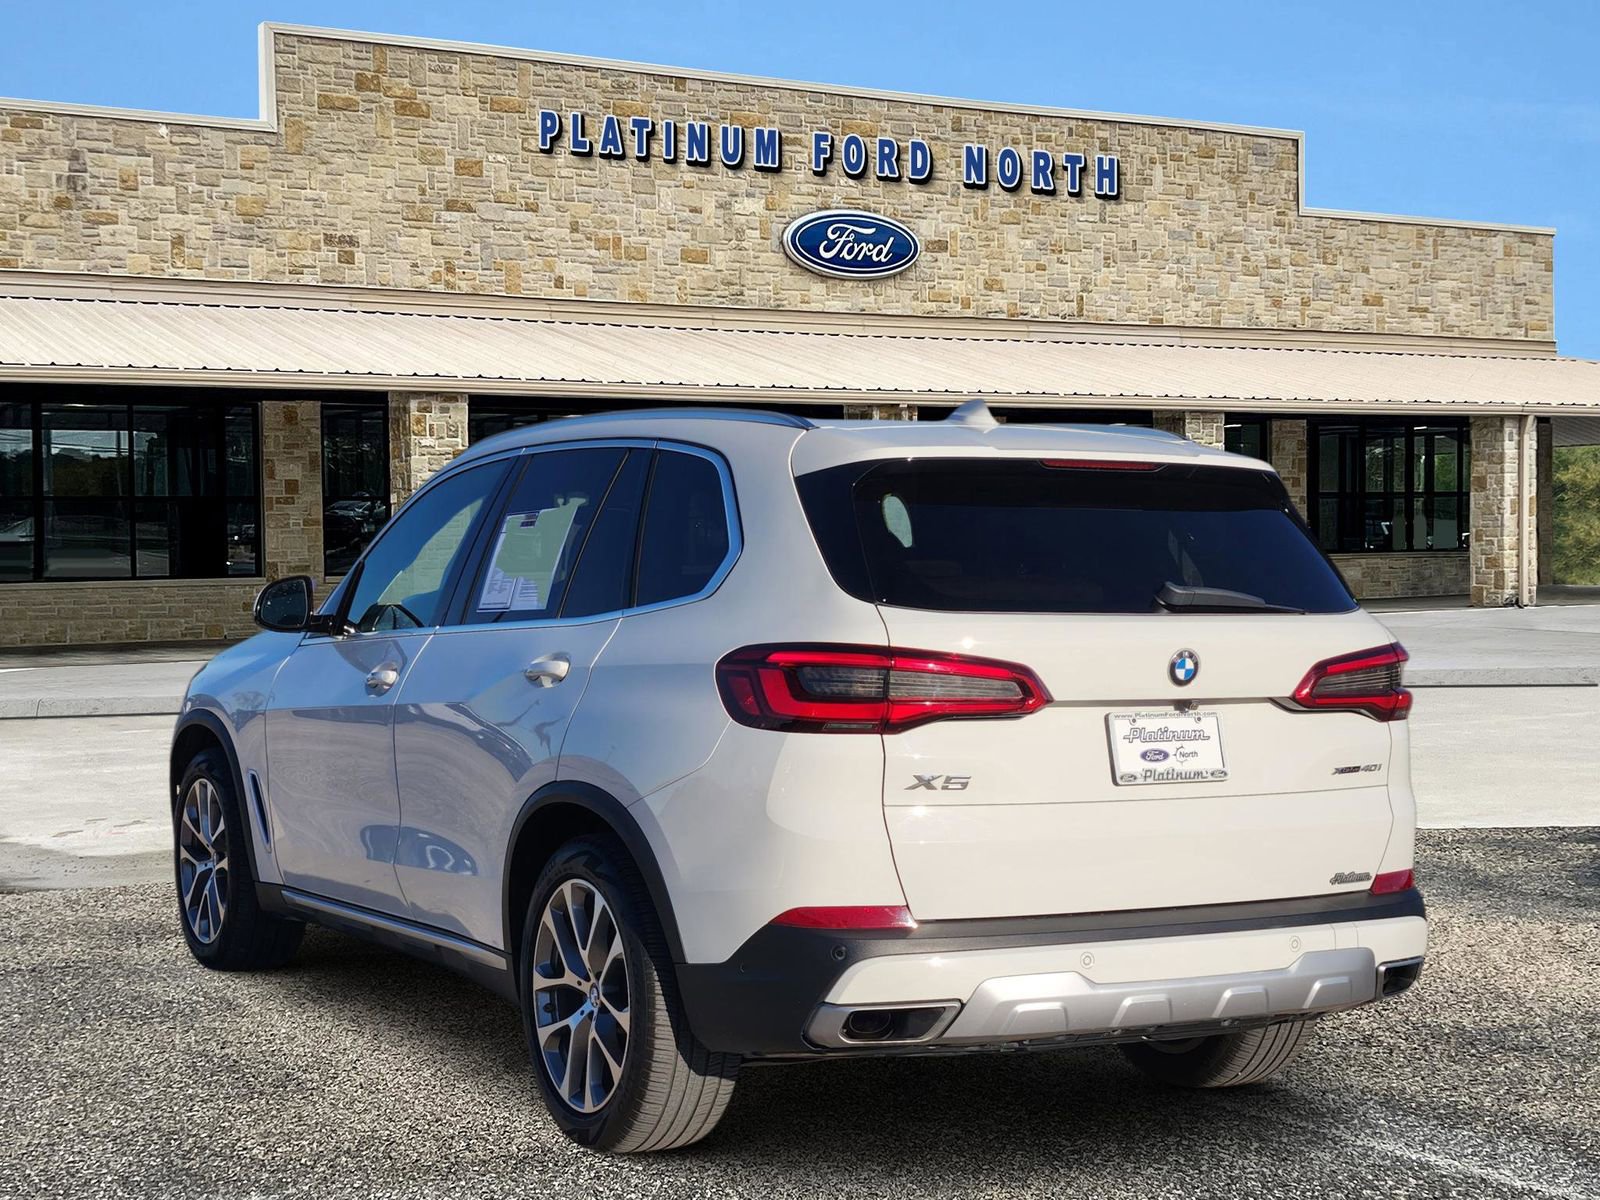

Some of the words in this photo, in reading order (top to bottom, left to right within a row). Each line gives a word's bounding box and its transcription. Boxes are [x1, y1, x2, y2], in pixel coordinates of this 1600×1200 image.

[538, 109, 782, 172] PLATINUM
[812, 131, 933, 183] FORD
[963, 144, 1120, 200] NORTH
[818, 224, 893, 264] Ford
[1123, 726, 1211, 743] Platinum
[1145, 750, 1165, 761] Ford
[1179, 750, 1199, 759] North
[903, 774, 972, 791] X5
[1142, 768, 1208, 782] Platinum
